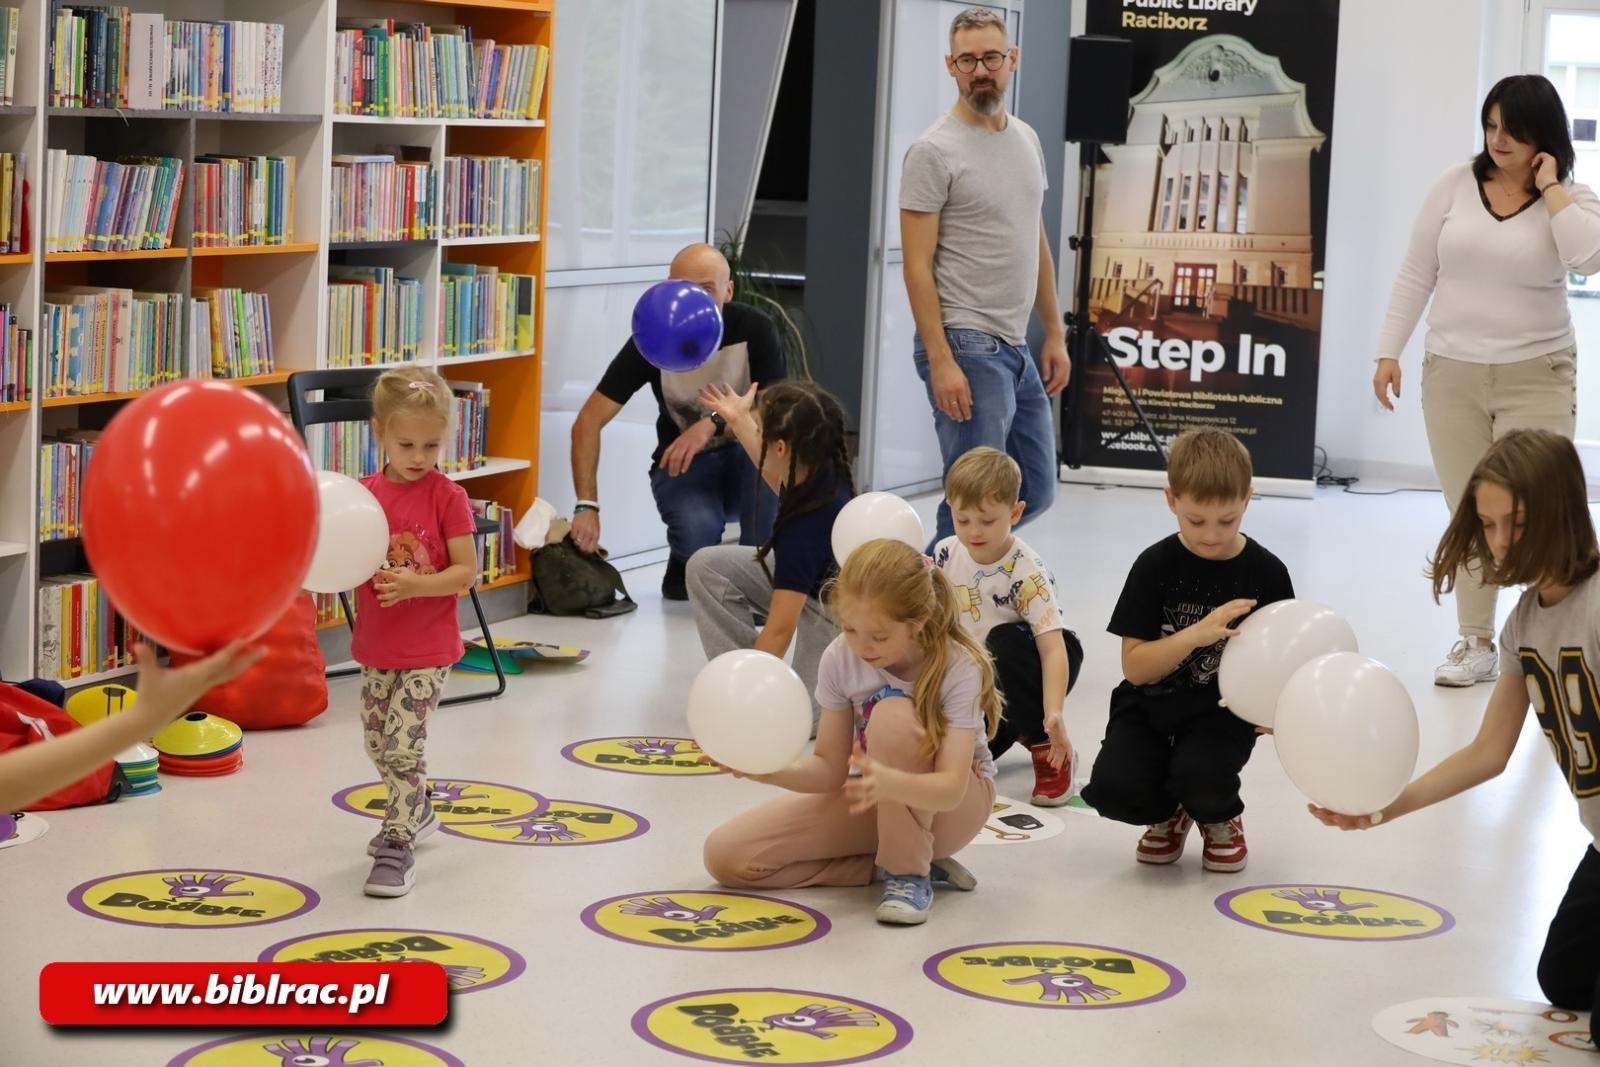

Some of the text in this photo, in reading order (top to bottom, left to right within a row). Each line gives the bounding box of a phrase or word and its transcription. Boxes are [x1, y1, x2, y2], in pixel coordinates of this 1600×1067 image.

[1187, 0, 1258, 16] Library
[1122, 11, 1208, 30] Raciborz
[1107, 326, 1286, 382] Step In
[1142, 388, 1191, 400] Powiatowa
[1192, 391, 1238, 402] Biblioteka
[1238, 394, 1283, 405] Publiczna
